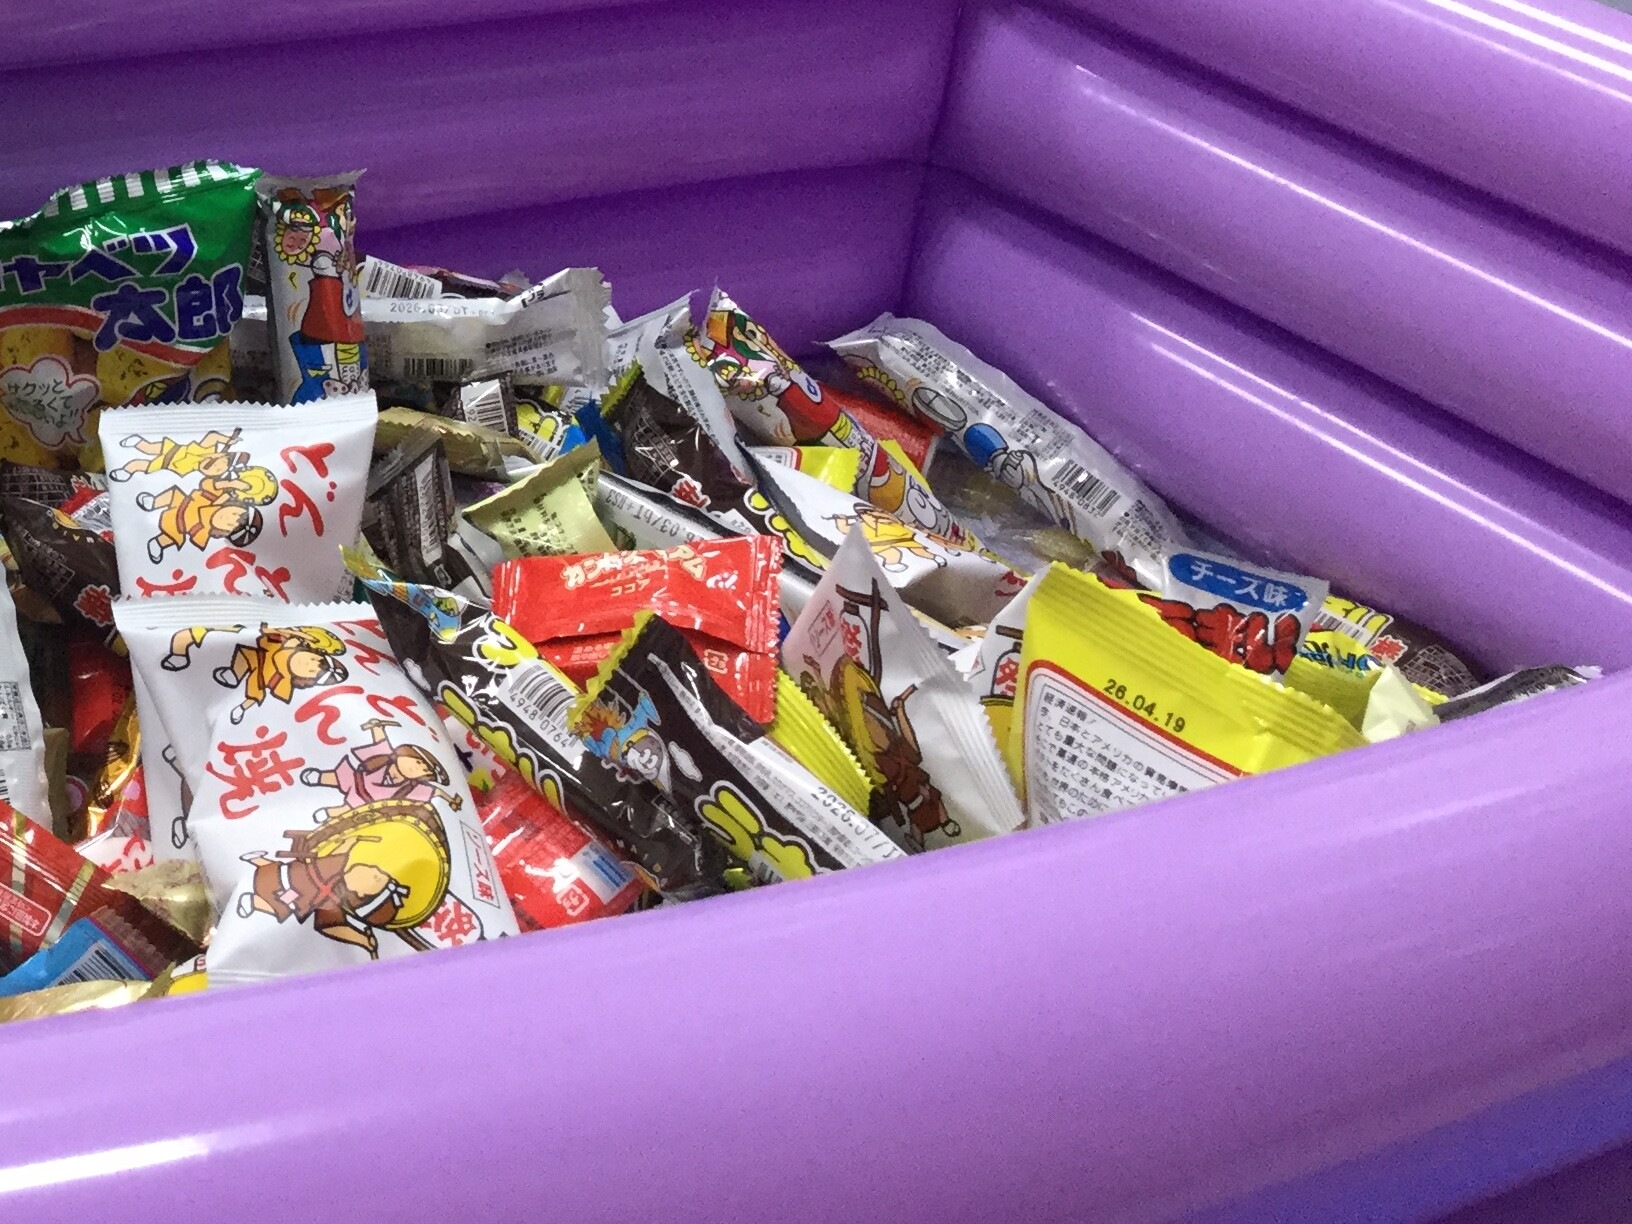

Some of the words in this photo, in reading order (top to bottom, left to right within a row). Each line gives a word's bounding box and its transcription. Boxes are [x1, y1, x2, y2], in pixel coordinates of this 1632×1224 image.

[91, 266, 244, 351] 太郎
[610, 578, 650, 598] ココア
[1190, 560, 1289, 606] チーズ味
[509, 692, 539, 721] 4948
[540, 720, 569, 750] 0764
[1103, 677, 1188, 735] 26.04.19
